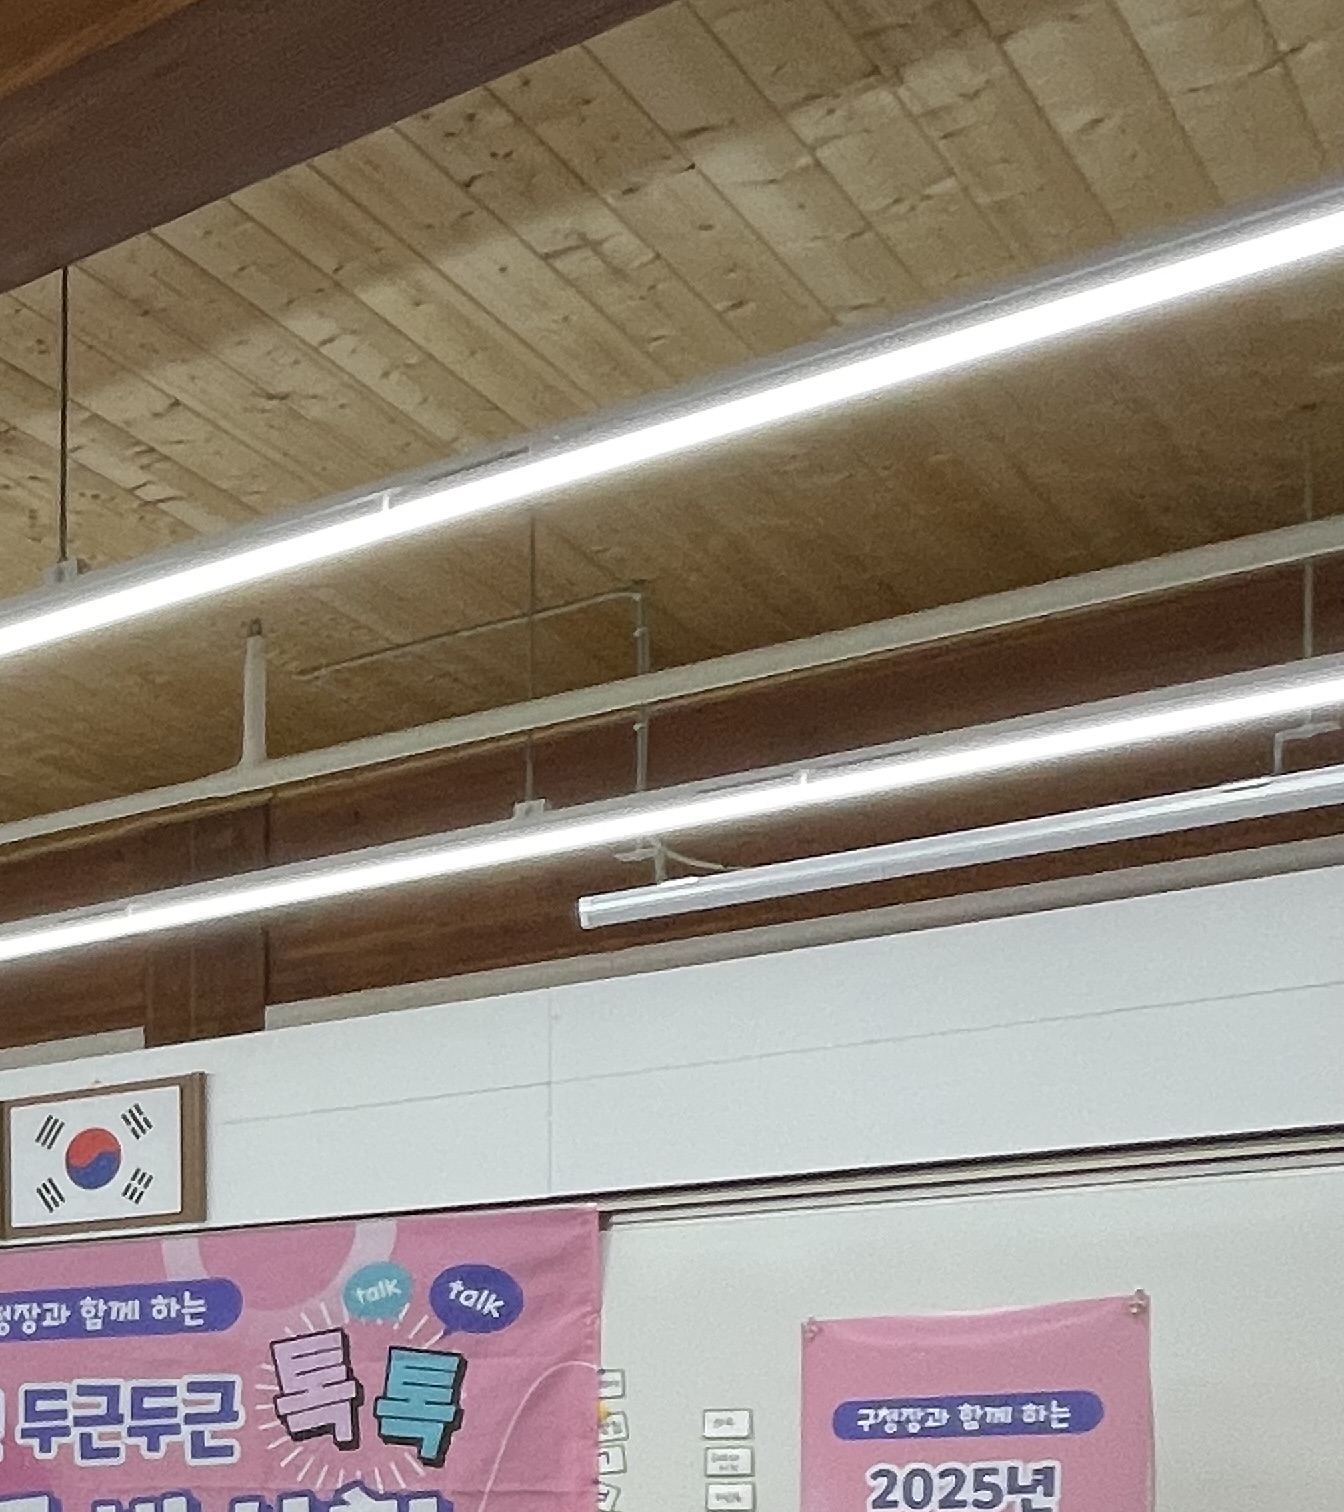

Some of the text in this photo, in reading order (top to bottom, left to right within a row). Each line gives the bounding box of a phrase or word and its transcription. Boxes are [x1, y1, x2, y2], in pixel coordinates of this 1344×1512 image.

[79, 1294, 142, 1332] 함께
[150, 1290, 208, 1328] 하는
[355, 1277, 402, 1306] talk
[448, 1280, 506, 1321] talk
[15, 1375, 244, 1466] 두근두근
[856, 1401, 1072, 1435] 구청장과 함께 하는
